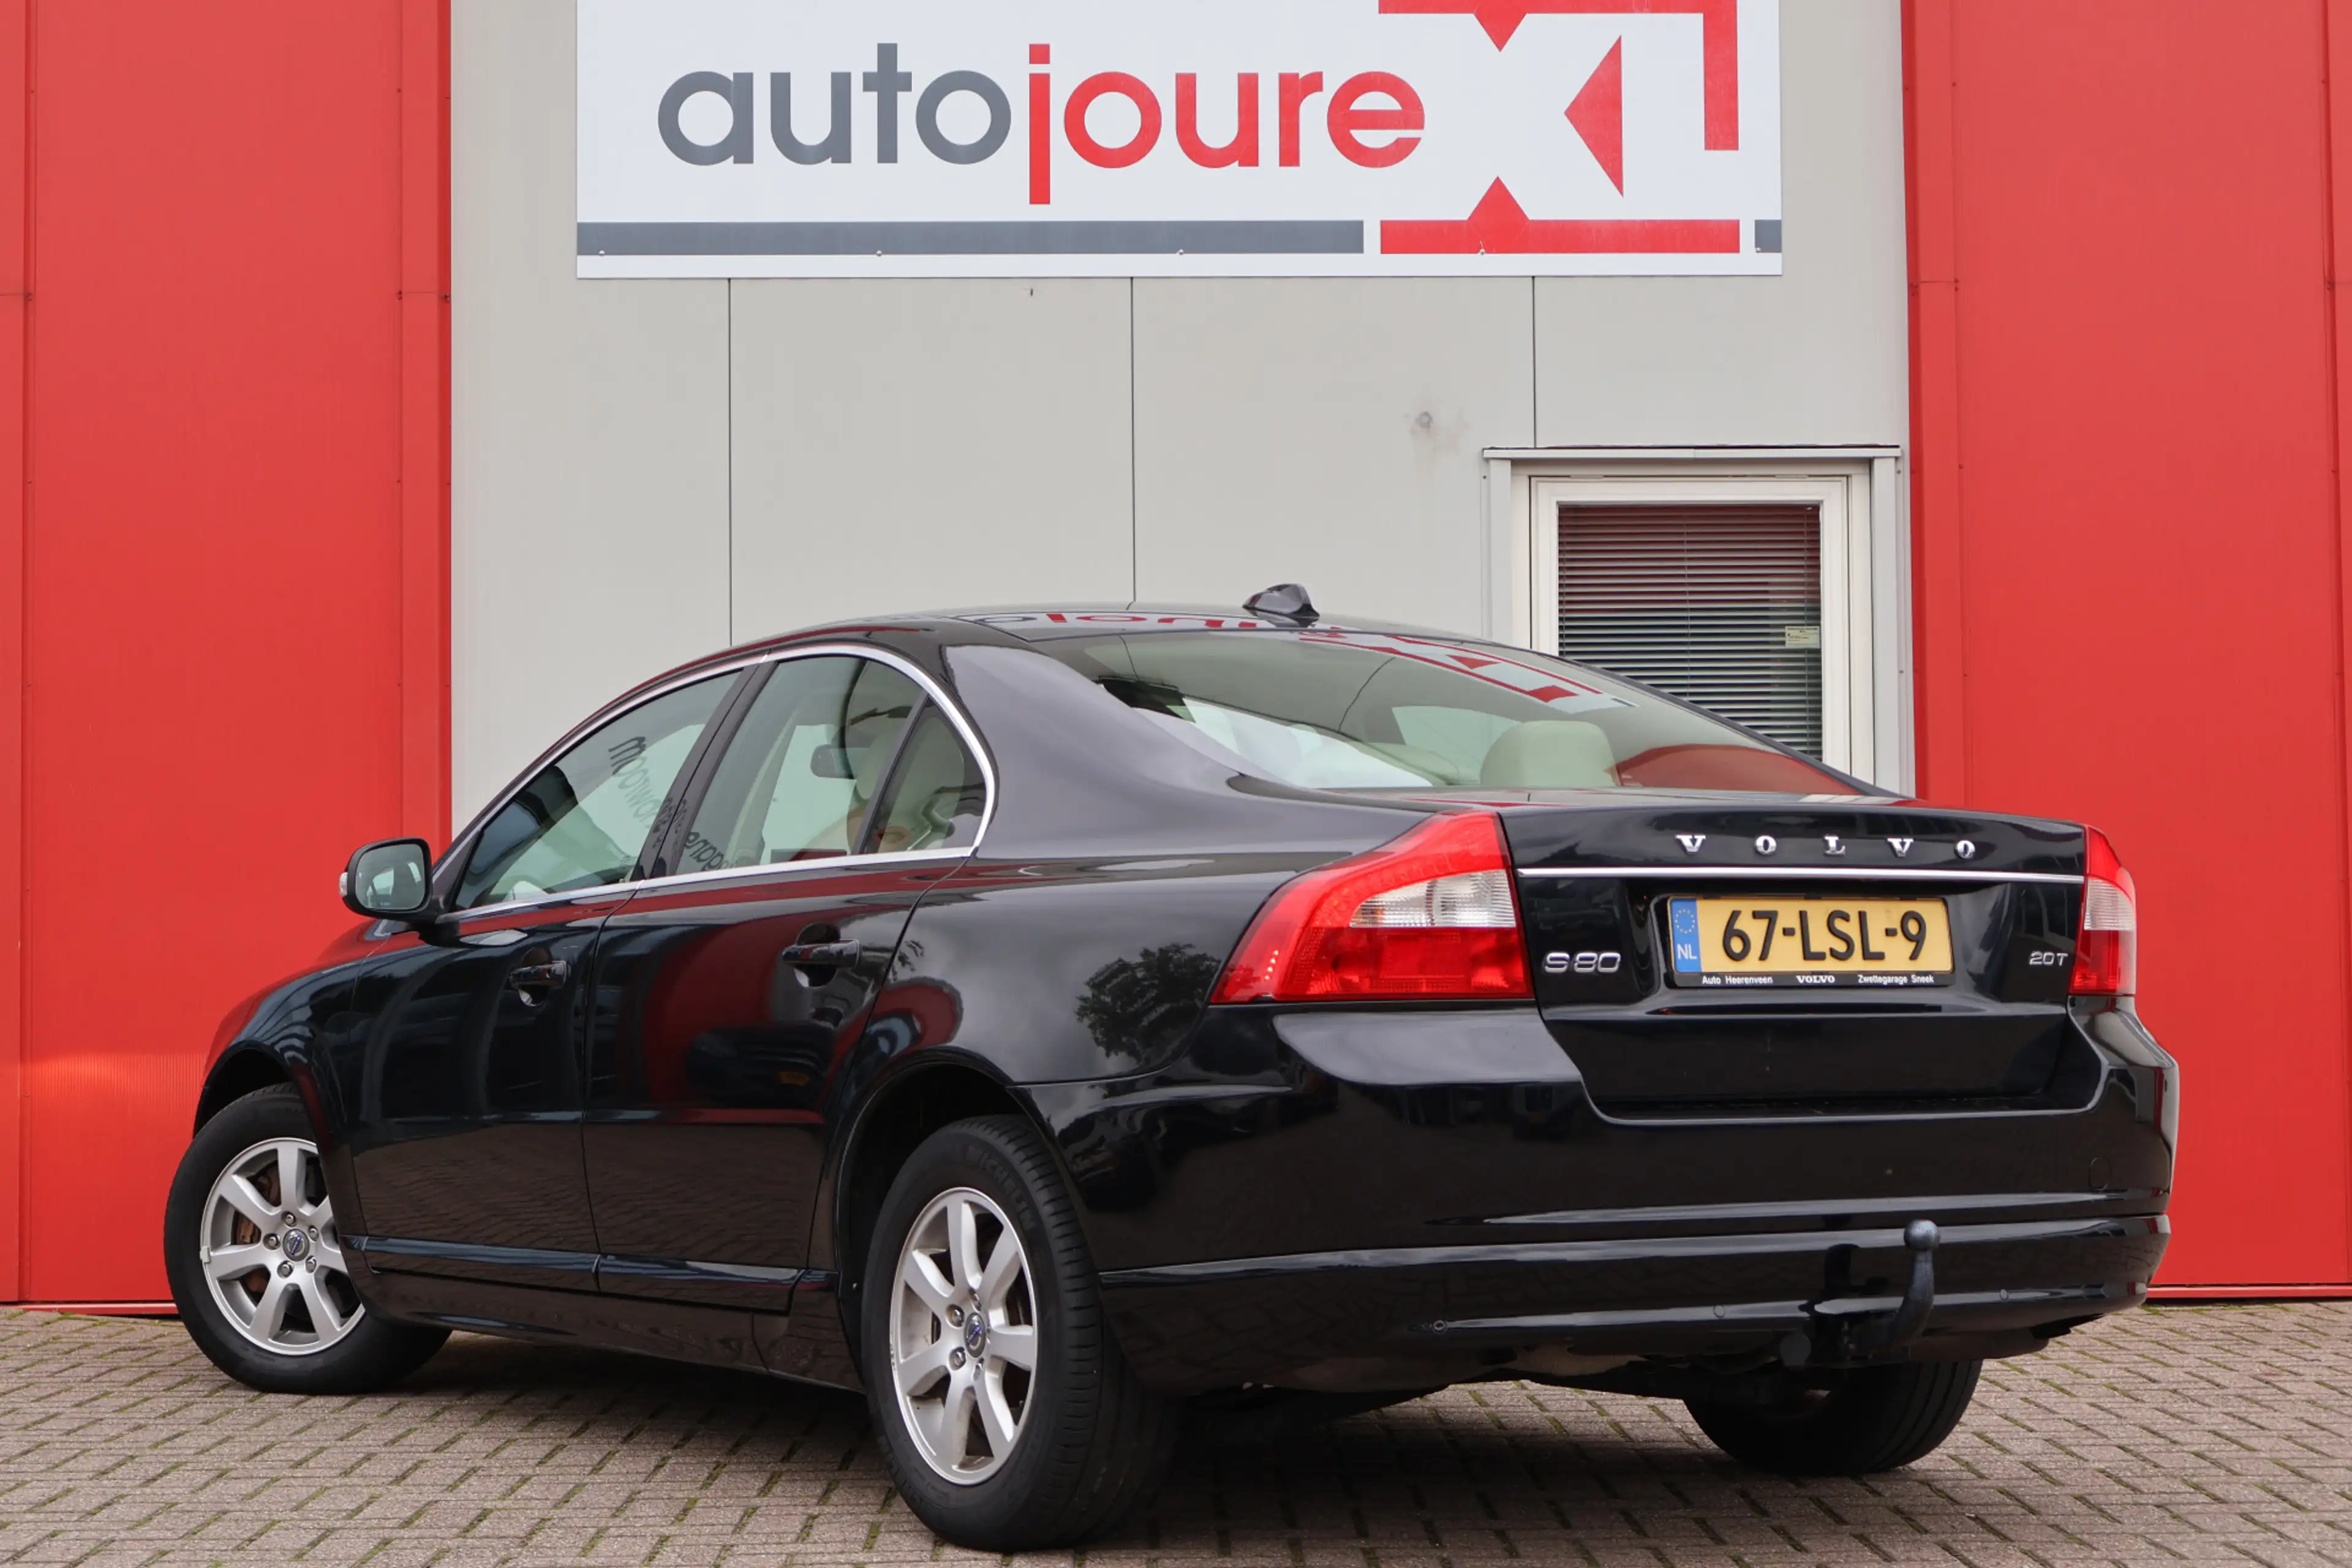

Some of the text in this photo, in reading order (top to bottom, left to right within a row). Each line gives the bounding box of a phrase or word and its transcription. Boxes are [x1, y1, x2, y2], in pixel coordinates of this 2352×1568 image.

[658, 42, 1425, 205] autojoure
[1675, 834, 1976, 859] VOLVO
[1722, 910, 1927, 961] 67-LSL-9
[1677, 943, 1697, 960] NL
[1544, 952, 1622, 973] S80
[1702, 975, 1774, 985] Auto Heerenveen
[1796, 975, 1836, 984] VOLVO
[1910, 974, 1934, 984] Sneek
